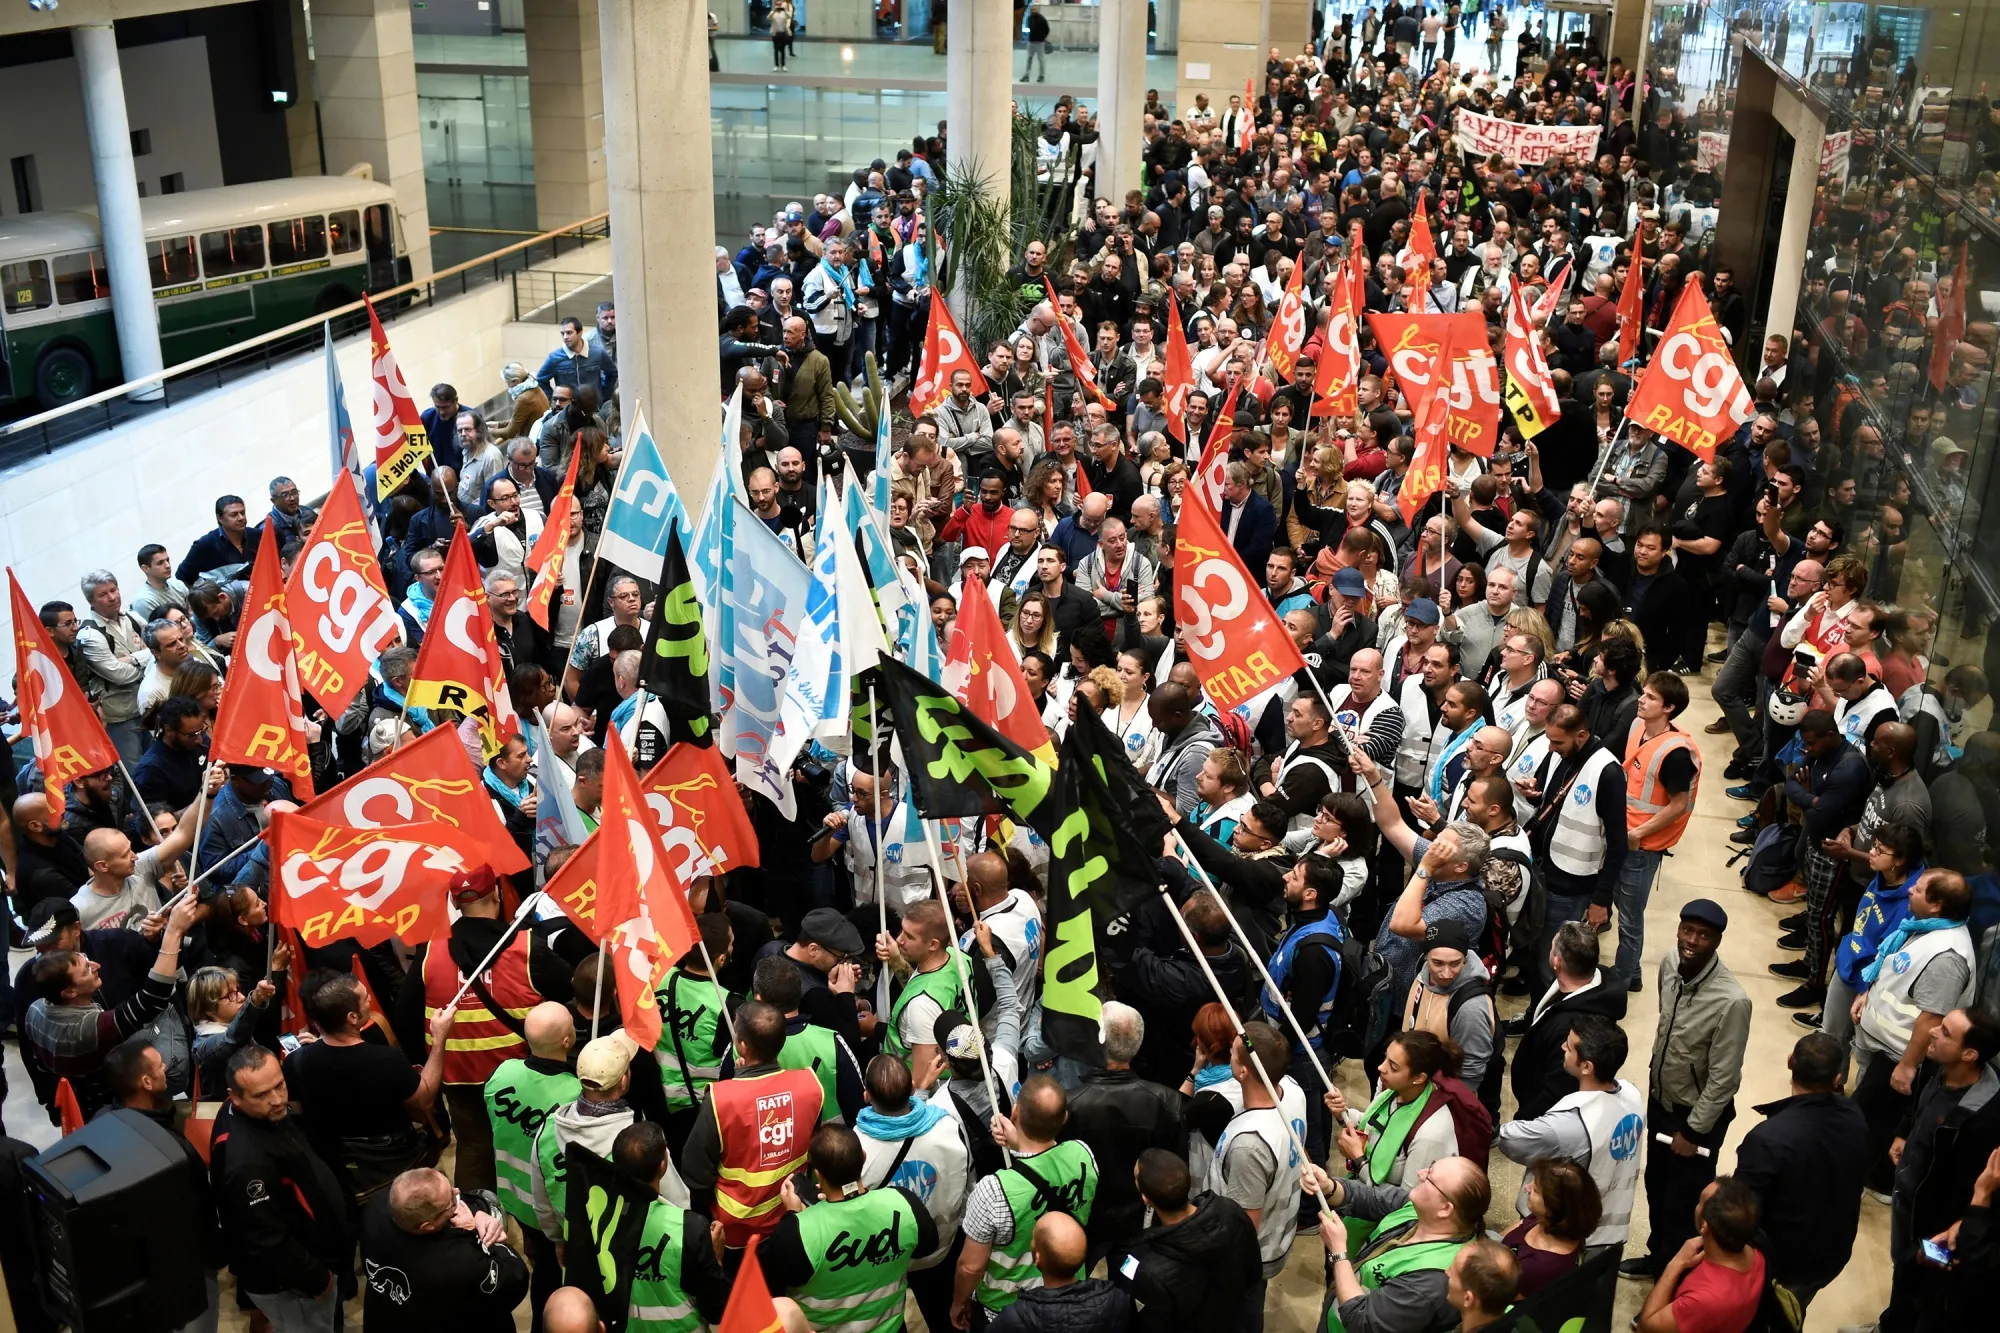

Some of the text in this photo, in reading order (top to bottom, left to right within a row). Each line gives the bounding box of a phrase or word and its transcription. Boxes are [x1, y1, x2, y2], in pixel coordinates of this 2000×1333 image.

[1478, 118, 1527, 144] VDF
[1549, 132, 1569, 144] ne
[1645, 403, 1717, 451] RATP
[1873, 903, 1885, 924] PARK
[758, 1095, 791, 1111] RATP
[759, 1117, 793, 1146] cgt
[872, 1247, 906, 1268] RATP
